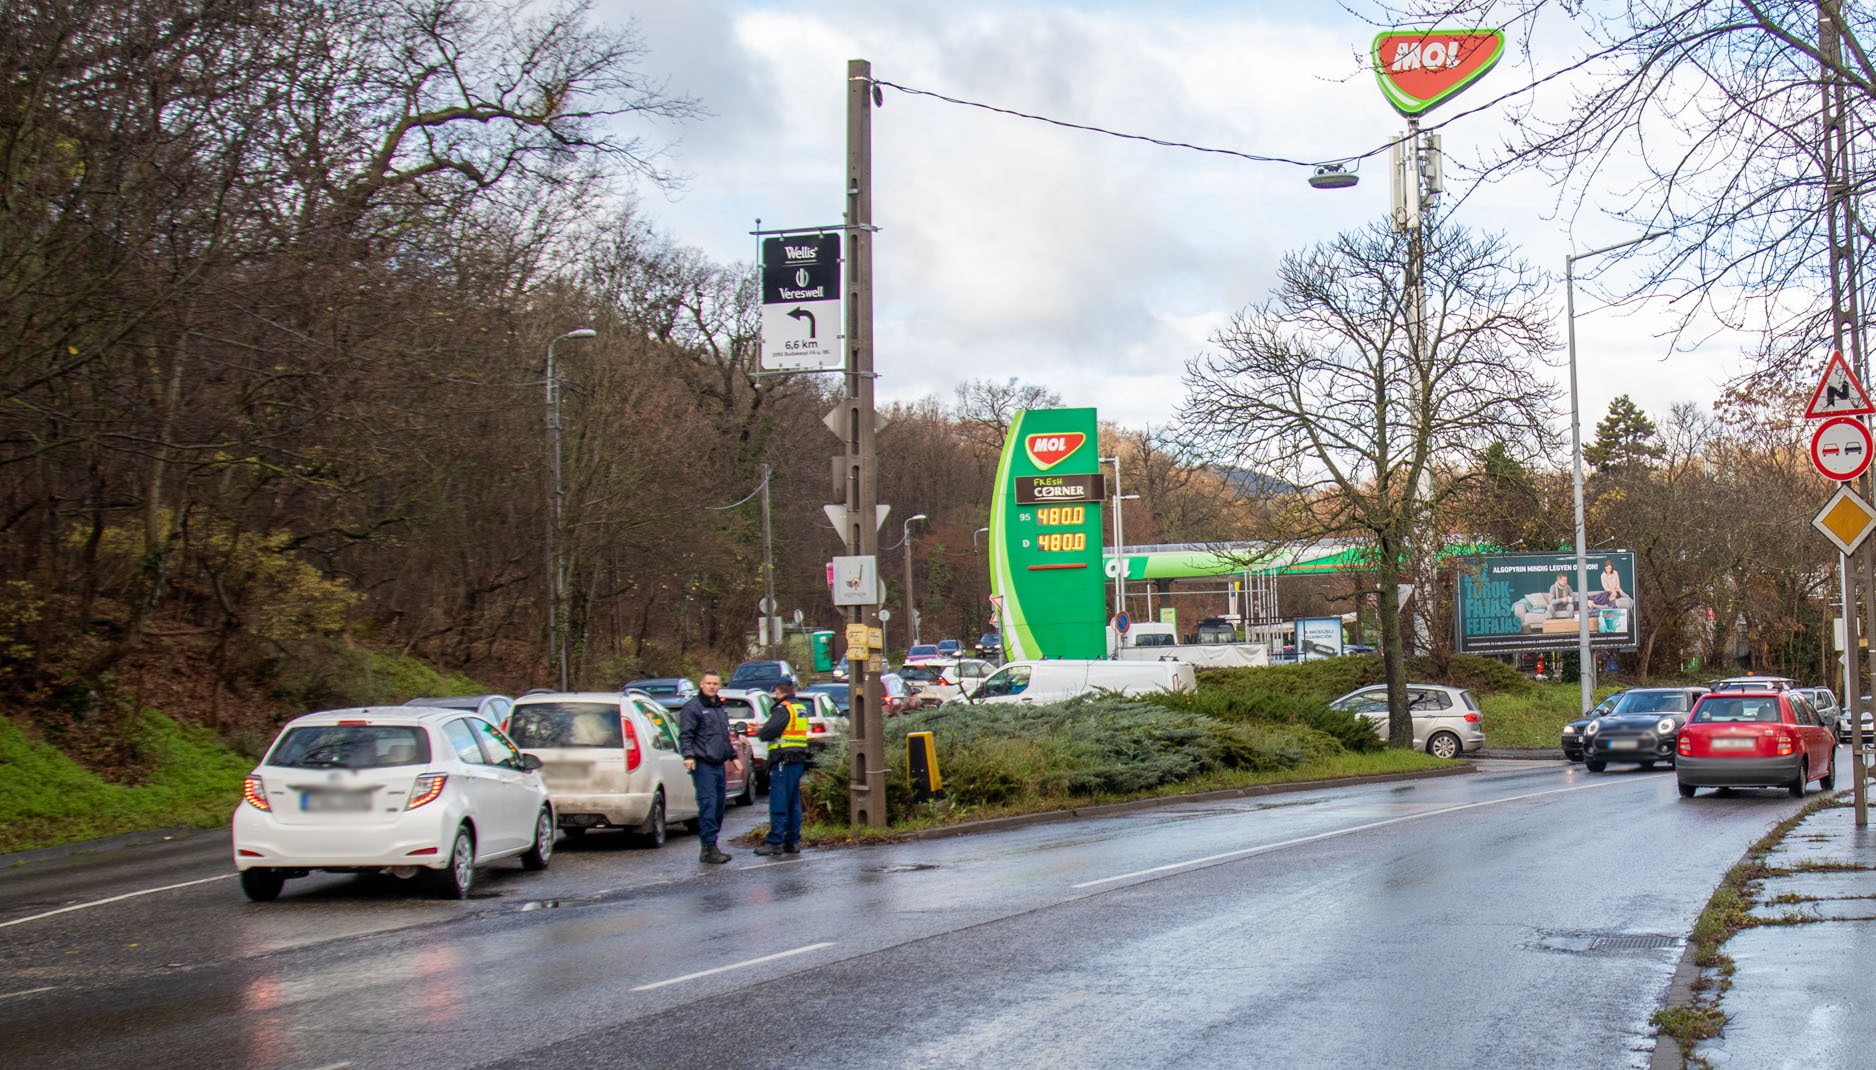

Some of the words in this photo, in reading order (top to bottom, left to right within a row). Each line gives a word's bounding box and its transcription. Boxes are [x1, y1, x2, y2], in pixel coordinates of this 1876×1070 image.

[1391, 41, 1461, 70] MOL
[779, 286, 825, 299] Vereswell
[785, 340, 800, 350] 6,6
[802, 339, 818, 348] km
[1033, 437, 1067, 452] MOL
[1034, 485, 1084, 497] CORNER
[1019, 513, 1031, 521] 95
[1022, 540, 1030, 548] D
[1492, 565, 1526, 574] ALGOPYRIN
[1527, 564, 1548, 573] MINDIG
[1549, 563, 1572, 572] LEGYEN
